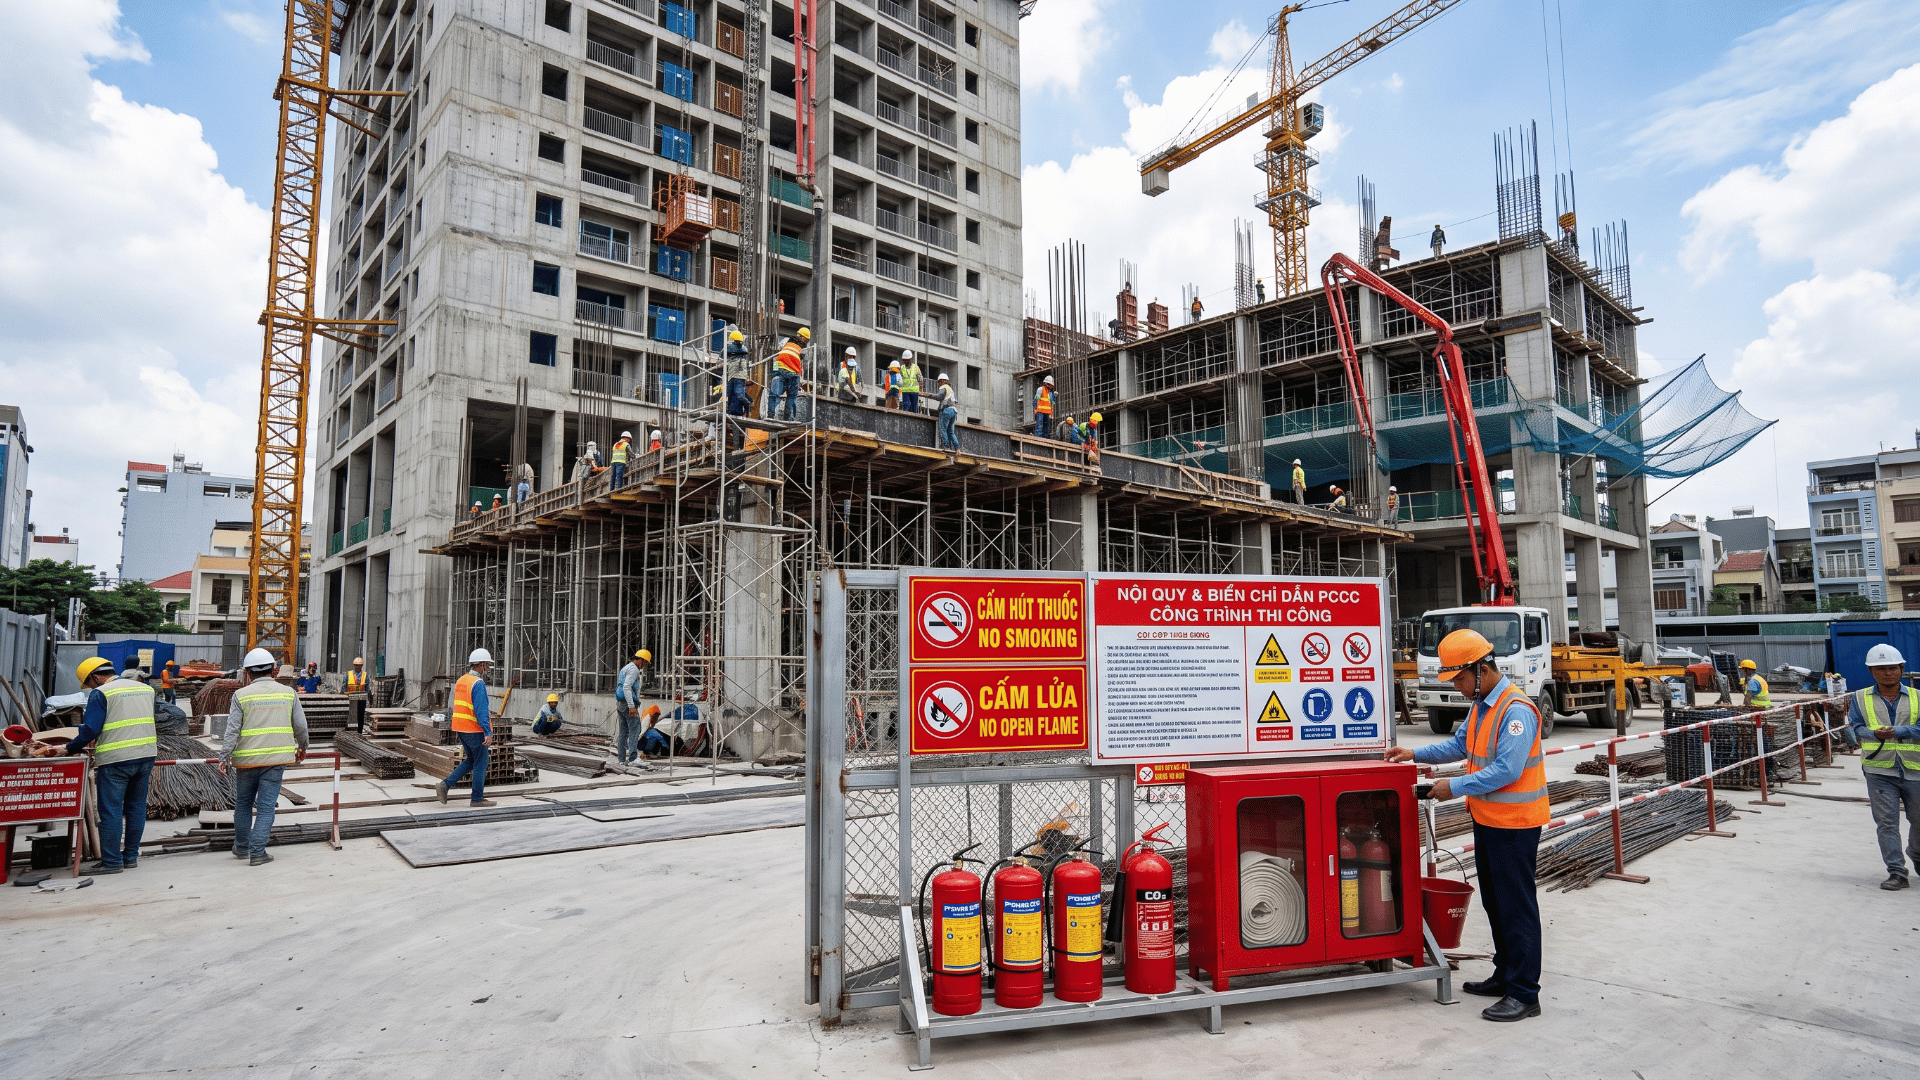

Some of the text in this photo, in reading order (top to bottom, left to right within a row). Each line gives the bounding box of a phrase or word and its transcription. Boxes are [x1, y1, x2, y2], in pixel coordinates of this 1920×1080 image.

[977, 588, 1078, 620] CẤM HÚT THUỐC
[1117, 584, 1147, 604] NỘI
[1152, 588, 1187, 602] QUY
[1192, 588, 1203, 602] &
[1318, 590, 1360, 604] PCCC
[1150, 604, 1332, 622] CÔNG TRÌNH THI CÔNG
[978, 627, 1078, 648] NO SMOKING
[979, 675, 1078, 710] CẤM LỬA
[979, 715, 1079, 737] NO OPEN FLAME
